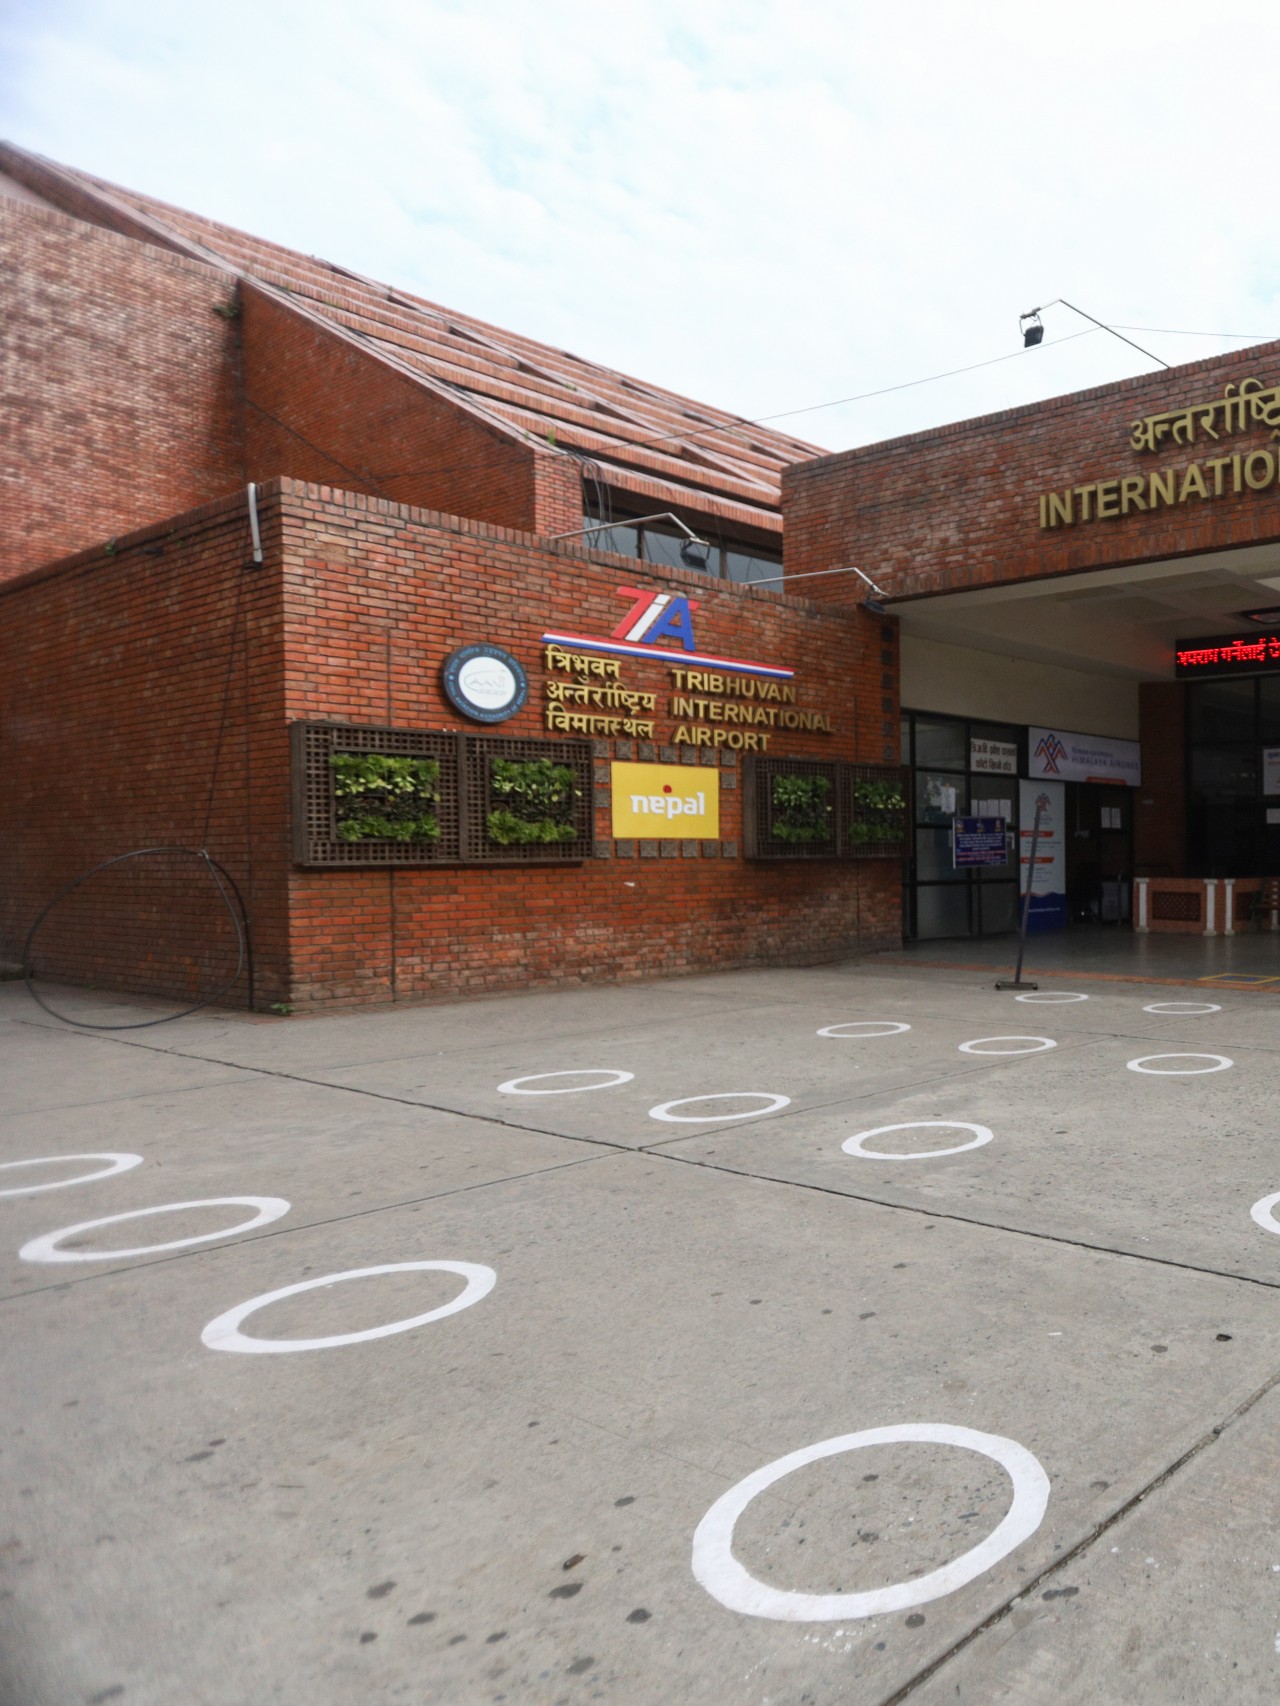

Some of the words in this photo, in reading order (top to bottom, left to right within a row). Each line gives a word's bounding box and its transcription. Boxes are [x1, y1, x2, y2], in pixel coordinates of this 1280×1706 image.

[545, 643, 621, 683] त्रिभुवन
[671, 669, 796, 703] TRIBHUVAN
[546, 701, 655, 739] विमानस्थल
[673, 697, 836, 732] INTERNATIONAL
[673, 725, 771, 751] AIRPORT
[1071, 755, 1107, 766] HIMALAYA
[630, 791, 705, 819] nepal
